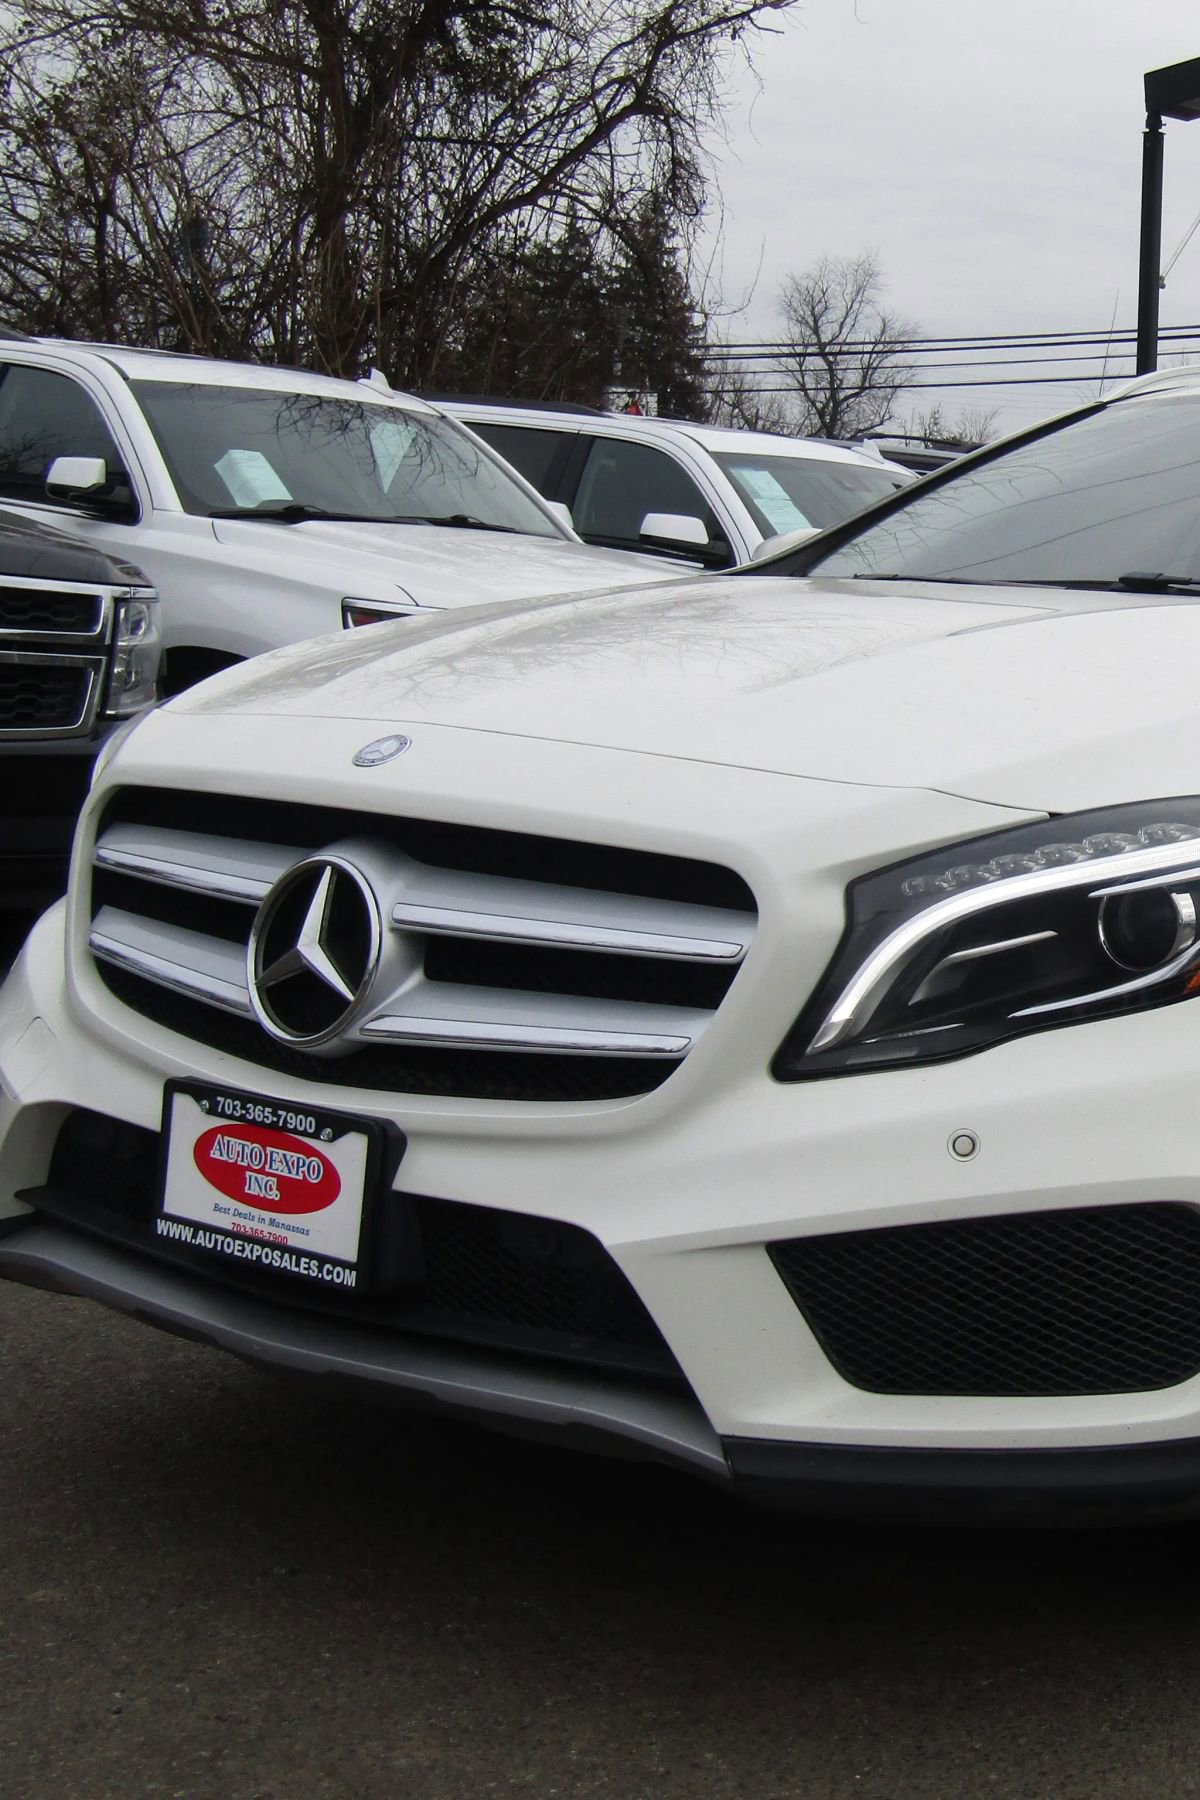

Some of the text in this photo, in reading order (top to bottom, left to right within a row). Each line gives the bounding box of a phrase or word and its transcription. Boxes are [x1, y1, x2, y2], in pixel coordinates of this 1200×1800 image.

[216, 1096, 316, 1134] 703-365-7900
[211, 1134, 323, 1183] AUTO EXPO
[245, 1172, 280, 1200] INC.
[212, 1202, 311, 1236] Best Deals in Manassas
[231, 1222, 289, 1246] 703-365-7900
[156, 1218, 358, 1287] WWW.AUTOEXPOSALES.COM
